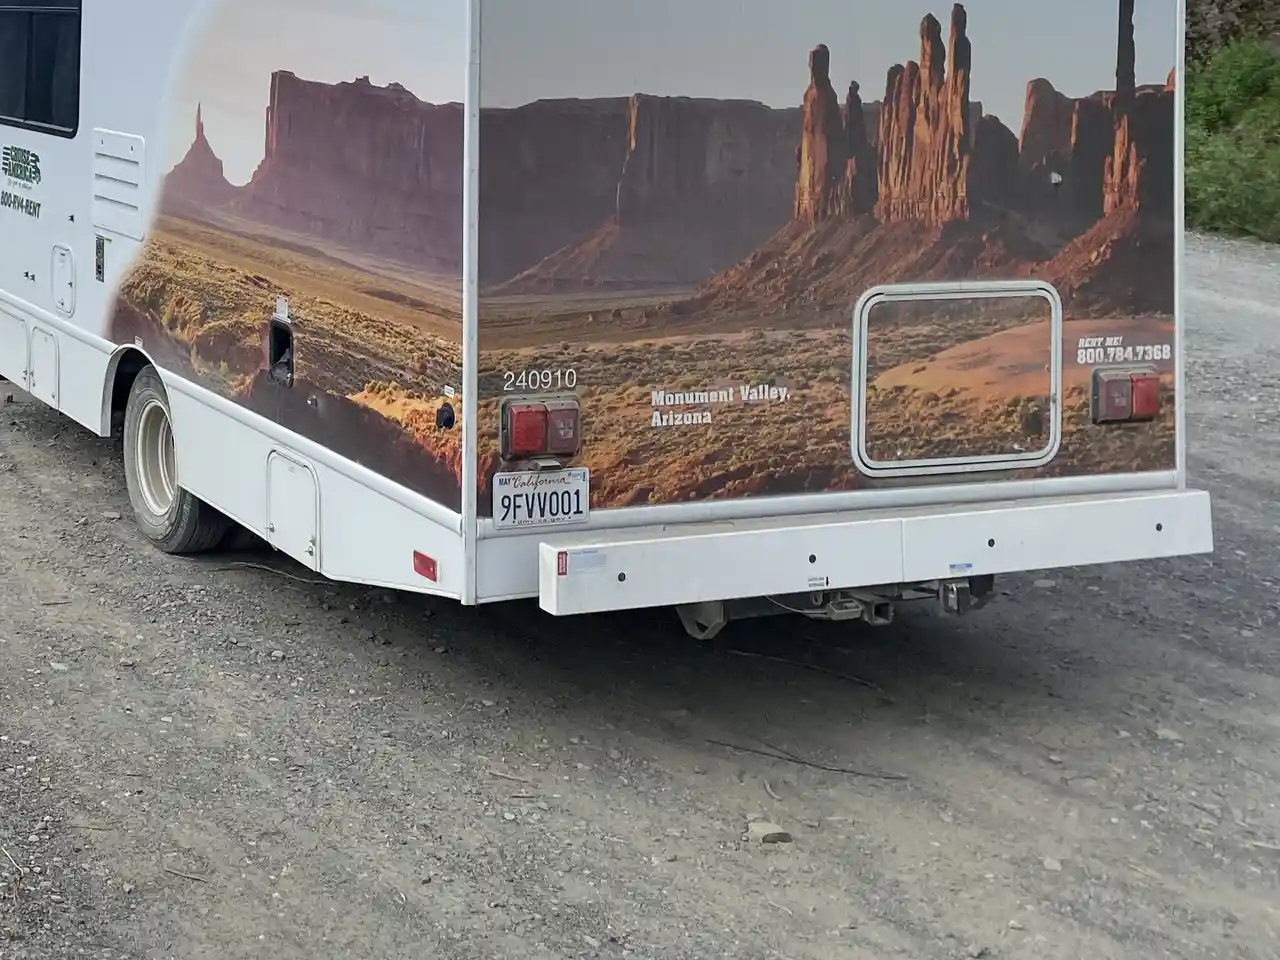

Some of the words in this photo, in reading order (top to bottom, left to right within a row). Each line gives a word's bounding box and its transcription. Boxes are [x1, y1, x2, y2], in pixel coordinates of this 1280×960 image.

[10, 145, 31, 166] CRUISE
[1078, 337, 1104, 348] RENT
[1077, 344, 1171, 364] 800.784.7368
[503, 369, 577, 390] 240910
[651, 387, 734, 406] Monument
[740, 384, 790, 402] Valley,
[651, 410, 712, 427] Arizona
[513, 474, 570, 490] California
[501, 488, 583, 521] 9FVV001
